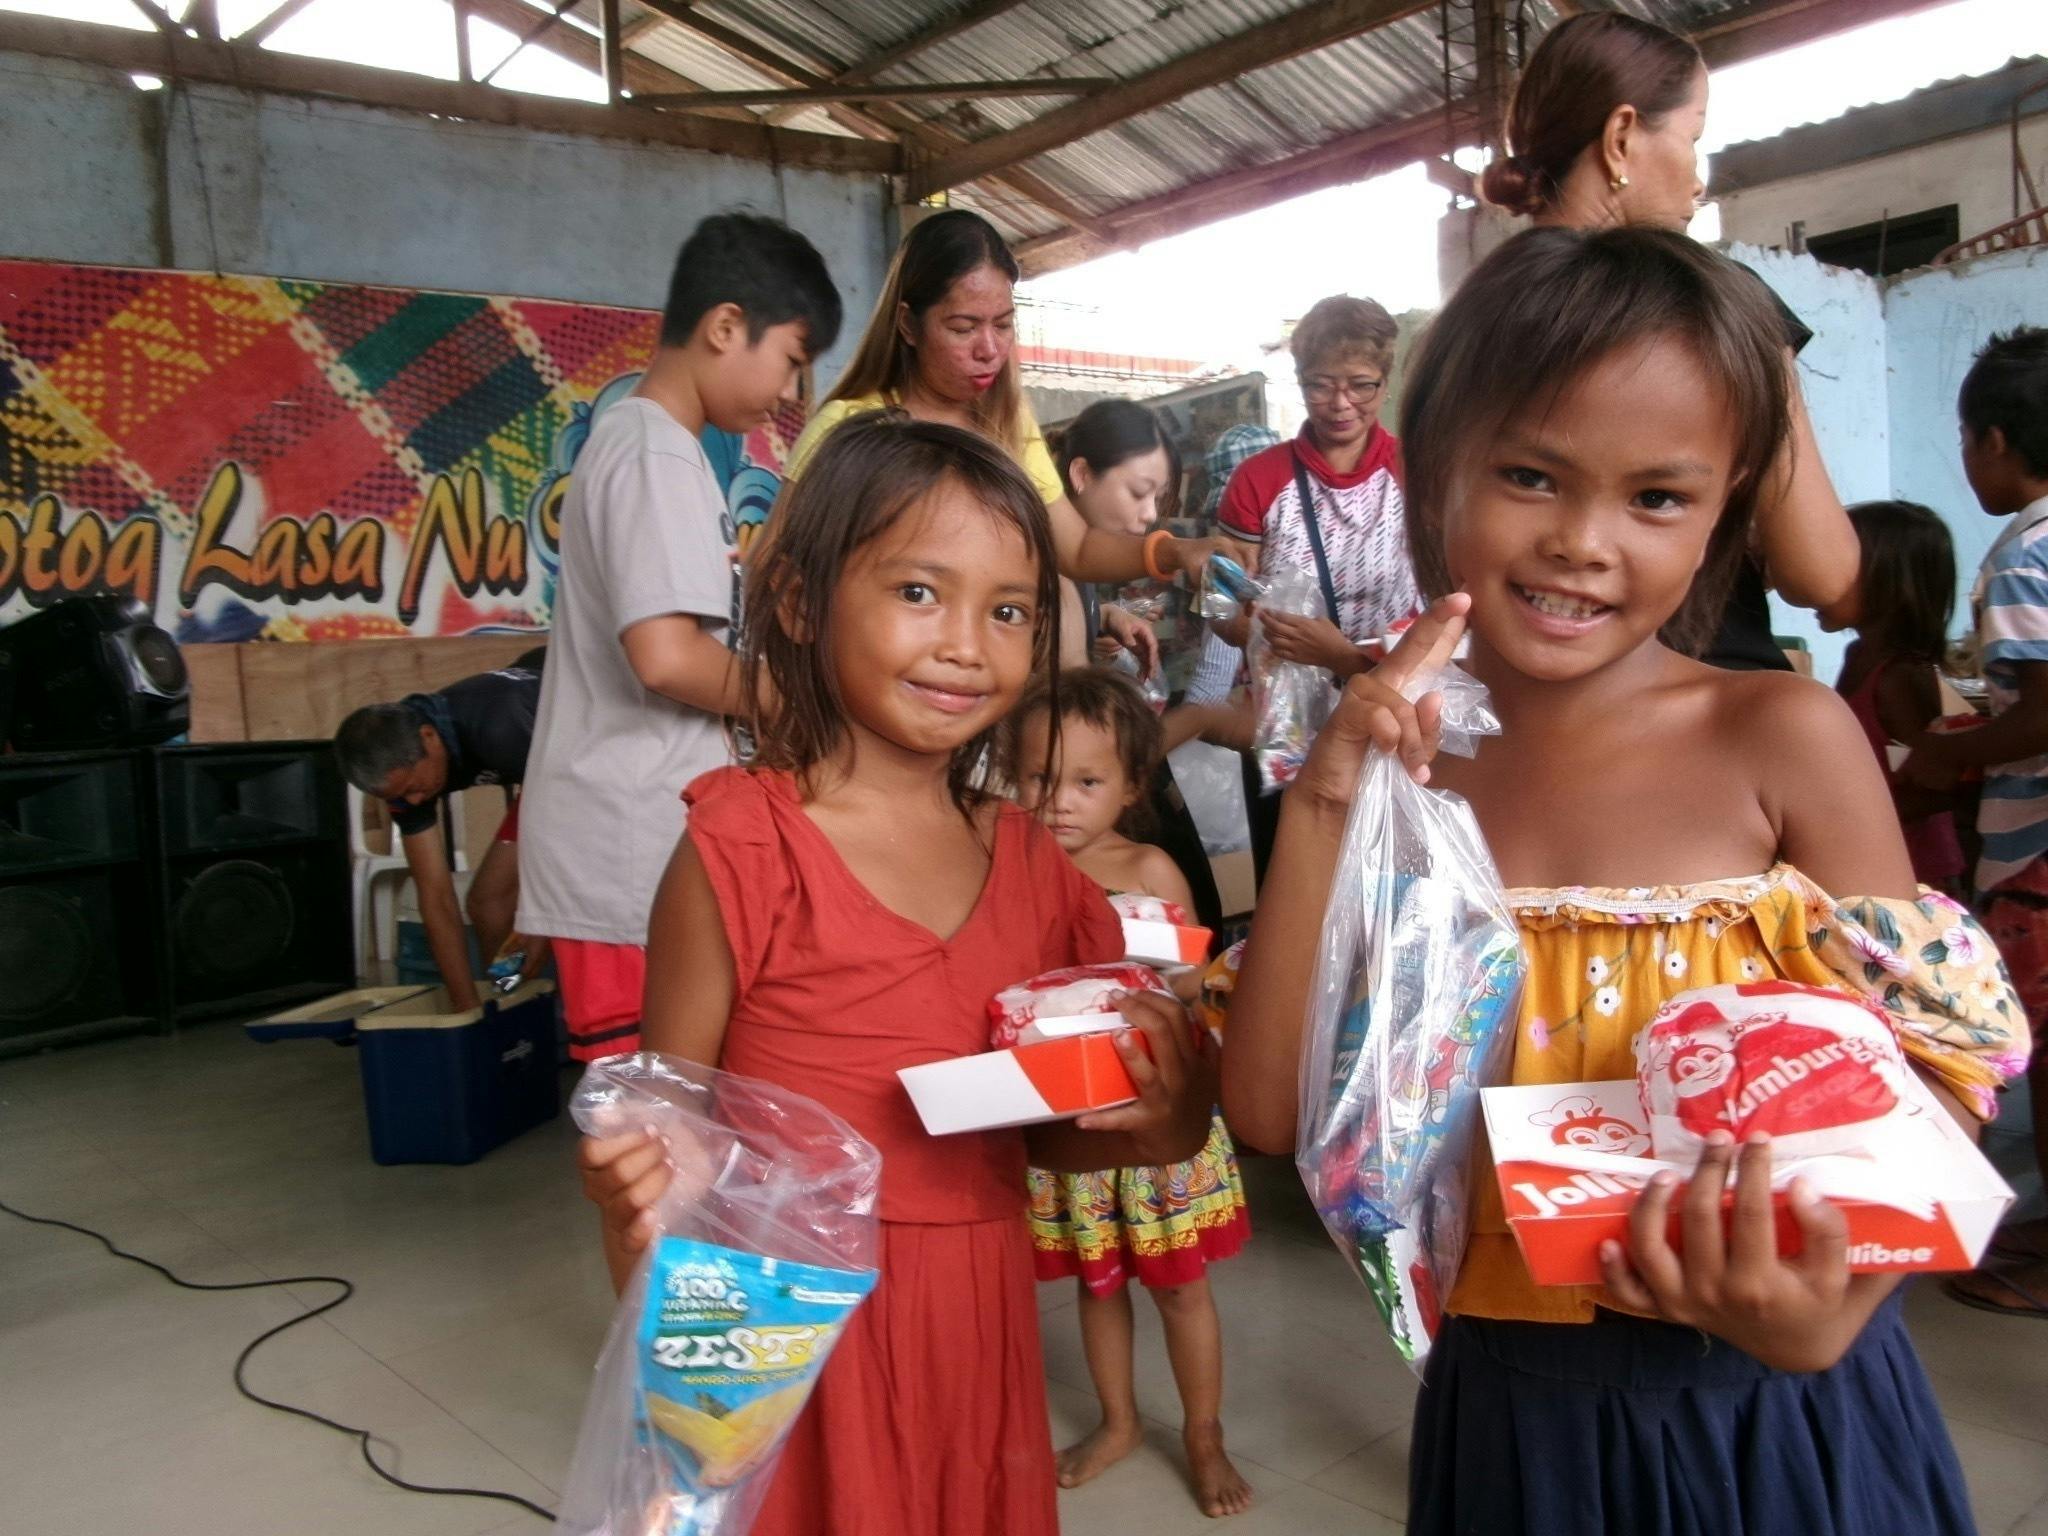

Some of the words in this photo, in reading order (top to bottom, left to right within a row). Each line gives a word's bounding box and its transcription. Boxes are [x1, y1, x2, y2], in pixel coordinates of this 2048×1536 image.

[179, 461, 385, 609] Lasa
[399, 467, 527, 625] Nu
[1511, 1170, 1646, 1218] Jolli
